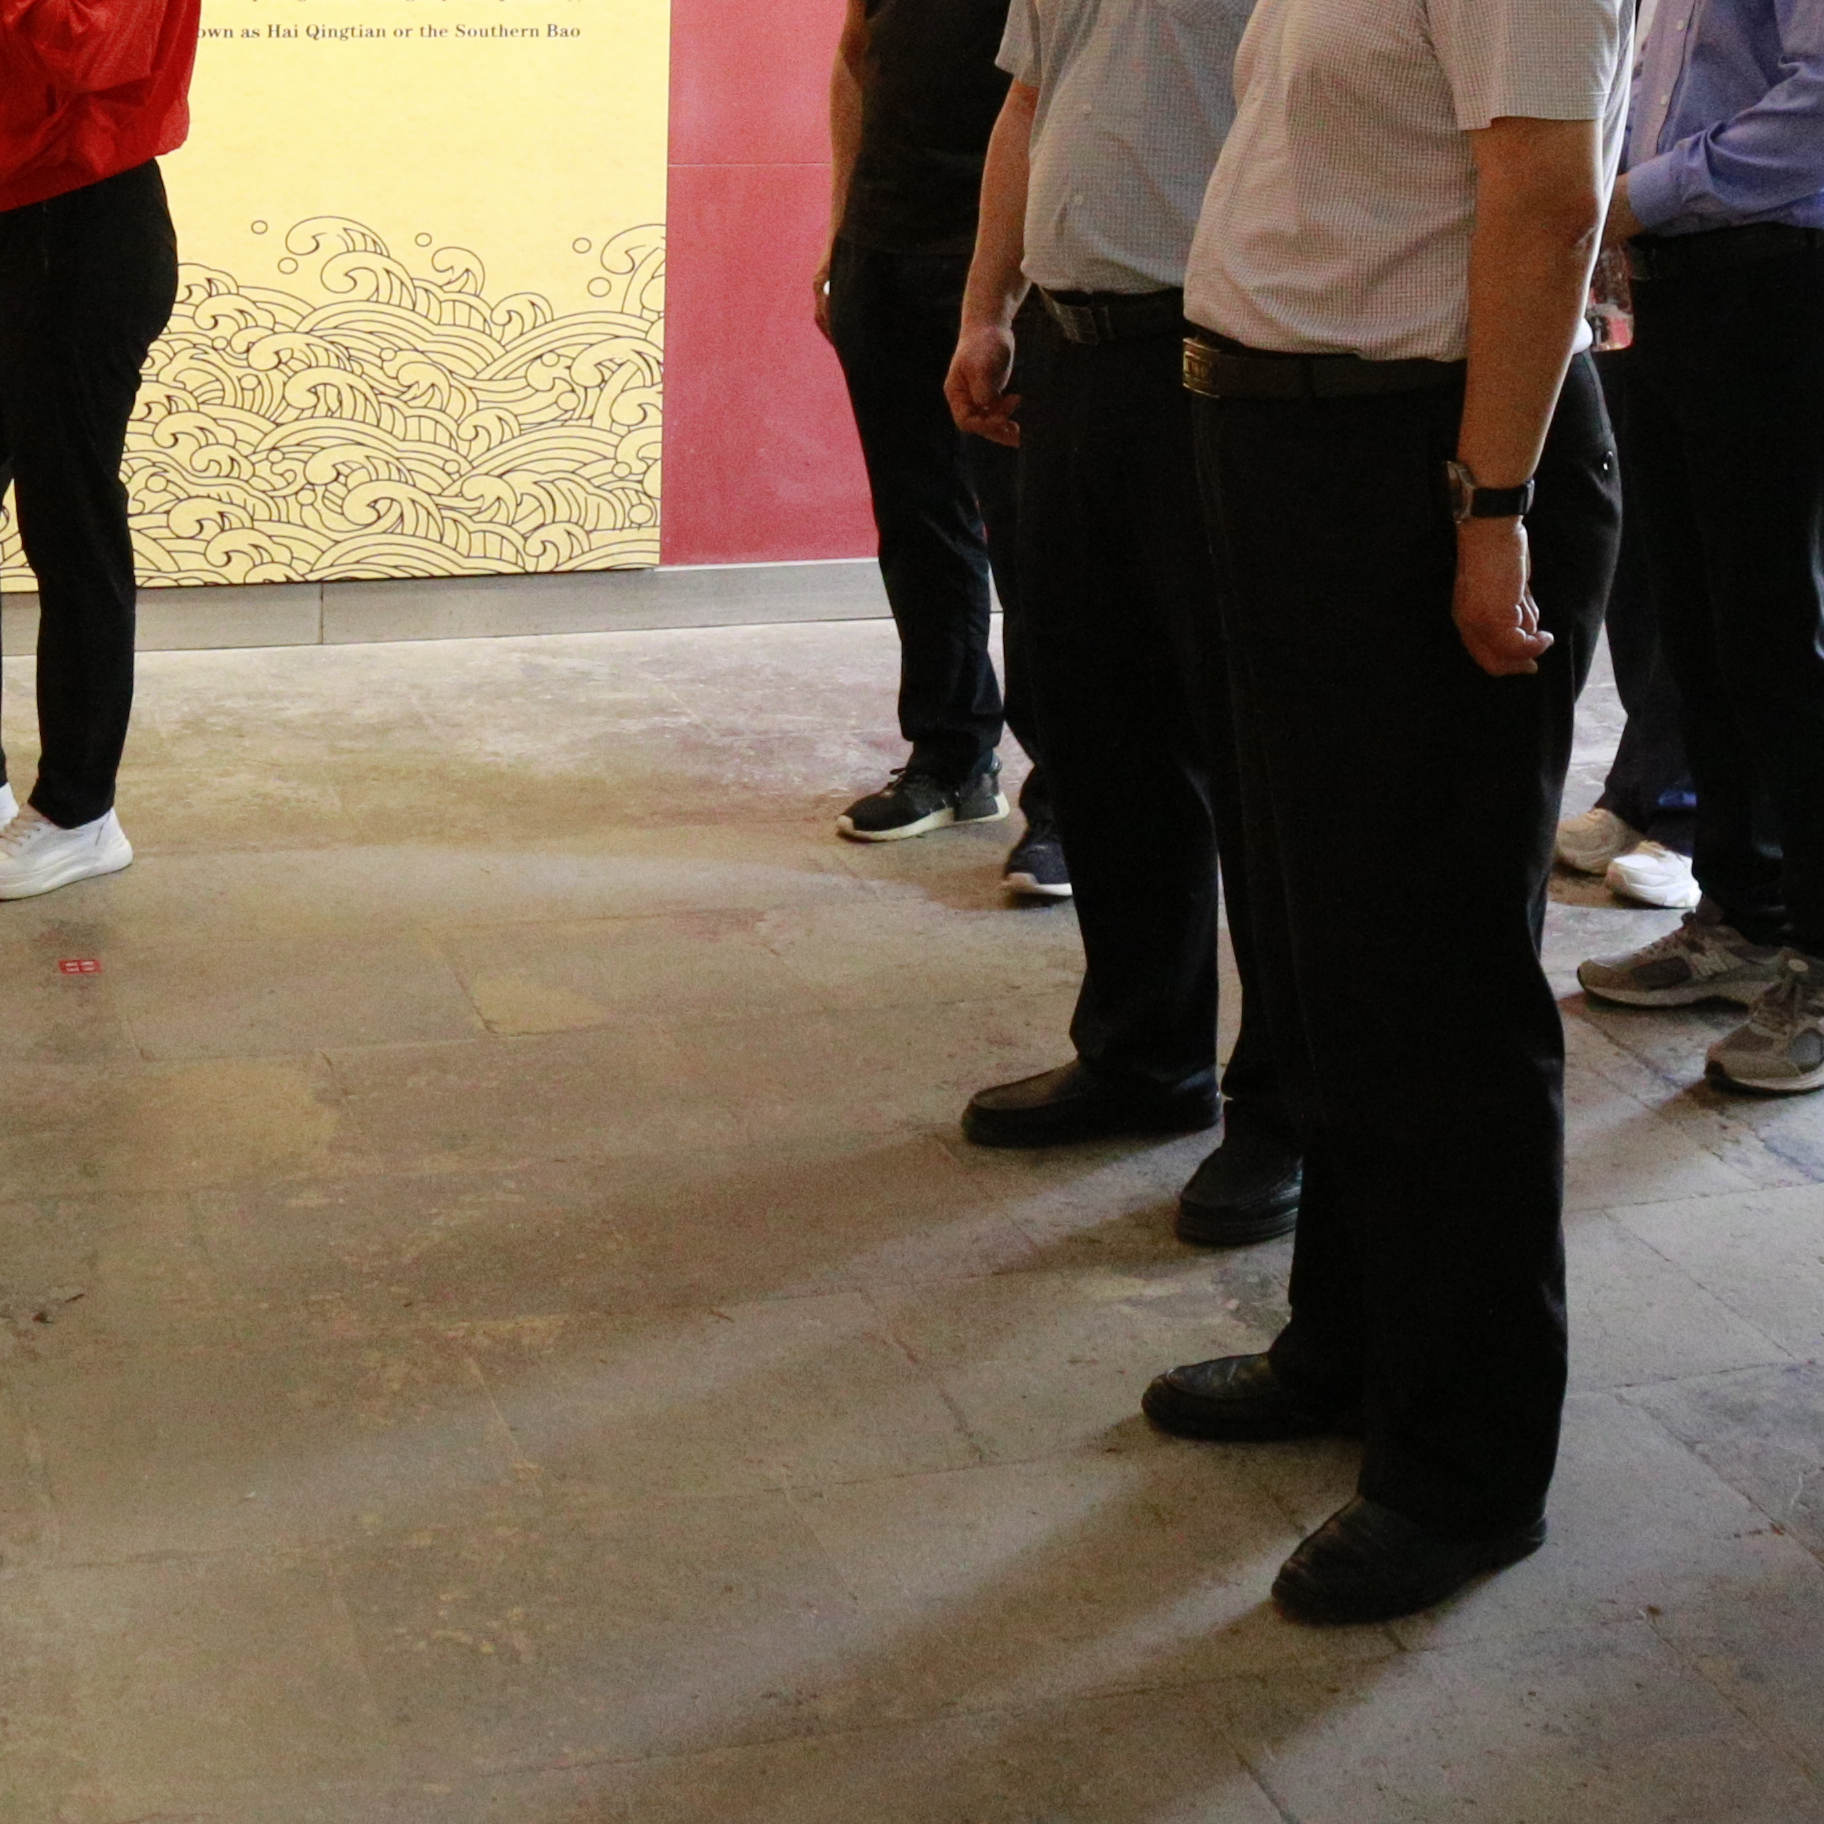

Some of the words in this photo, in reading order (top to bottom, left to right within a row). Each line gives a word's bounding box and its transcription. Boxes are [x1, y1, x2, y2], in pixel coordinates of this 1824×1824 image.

[239, 28, 261, 39] as
[267, 23, 299, 39] Hai
[305, 23, 387, 42] Qingtian
[392, 27, 414, 38] or
[419, 23, 449, 39] the
[454, 23, 540, 39] Southern
[546, 23, 581, 38] Bao
